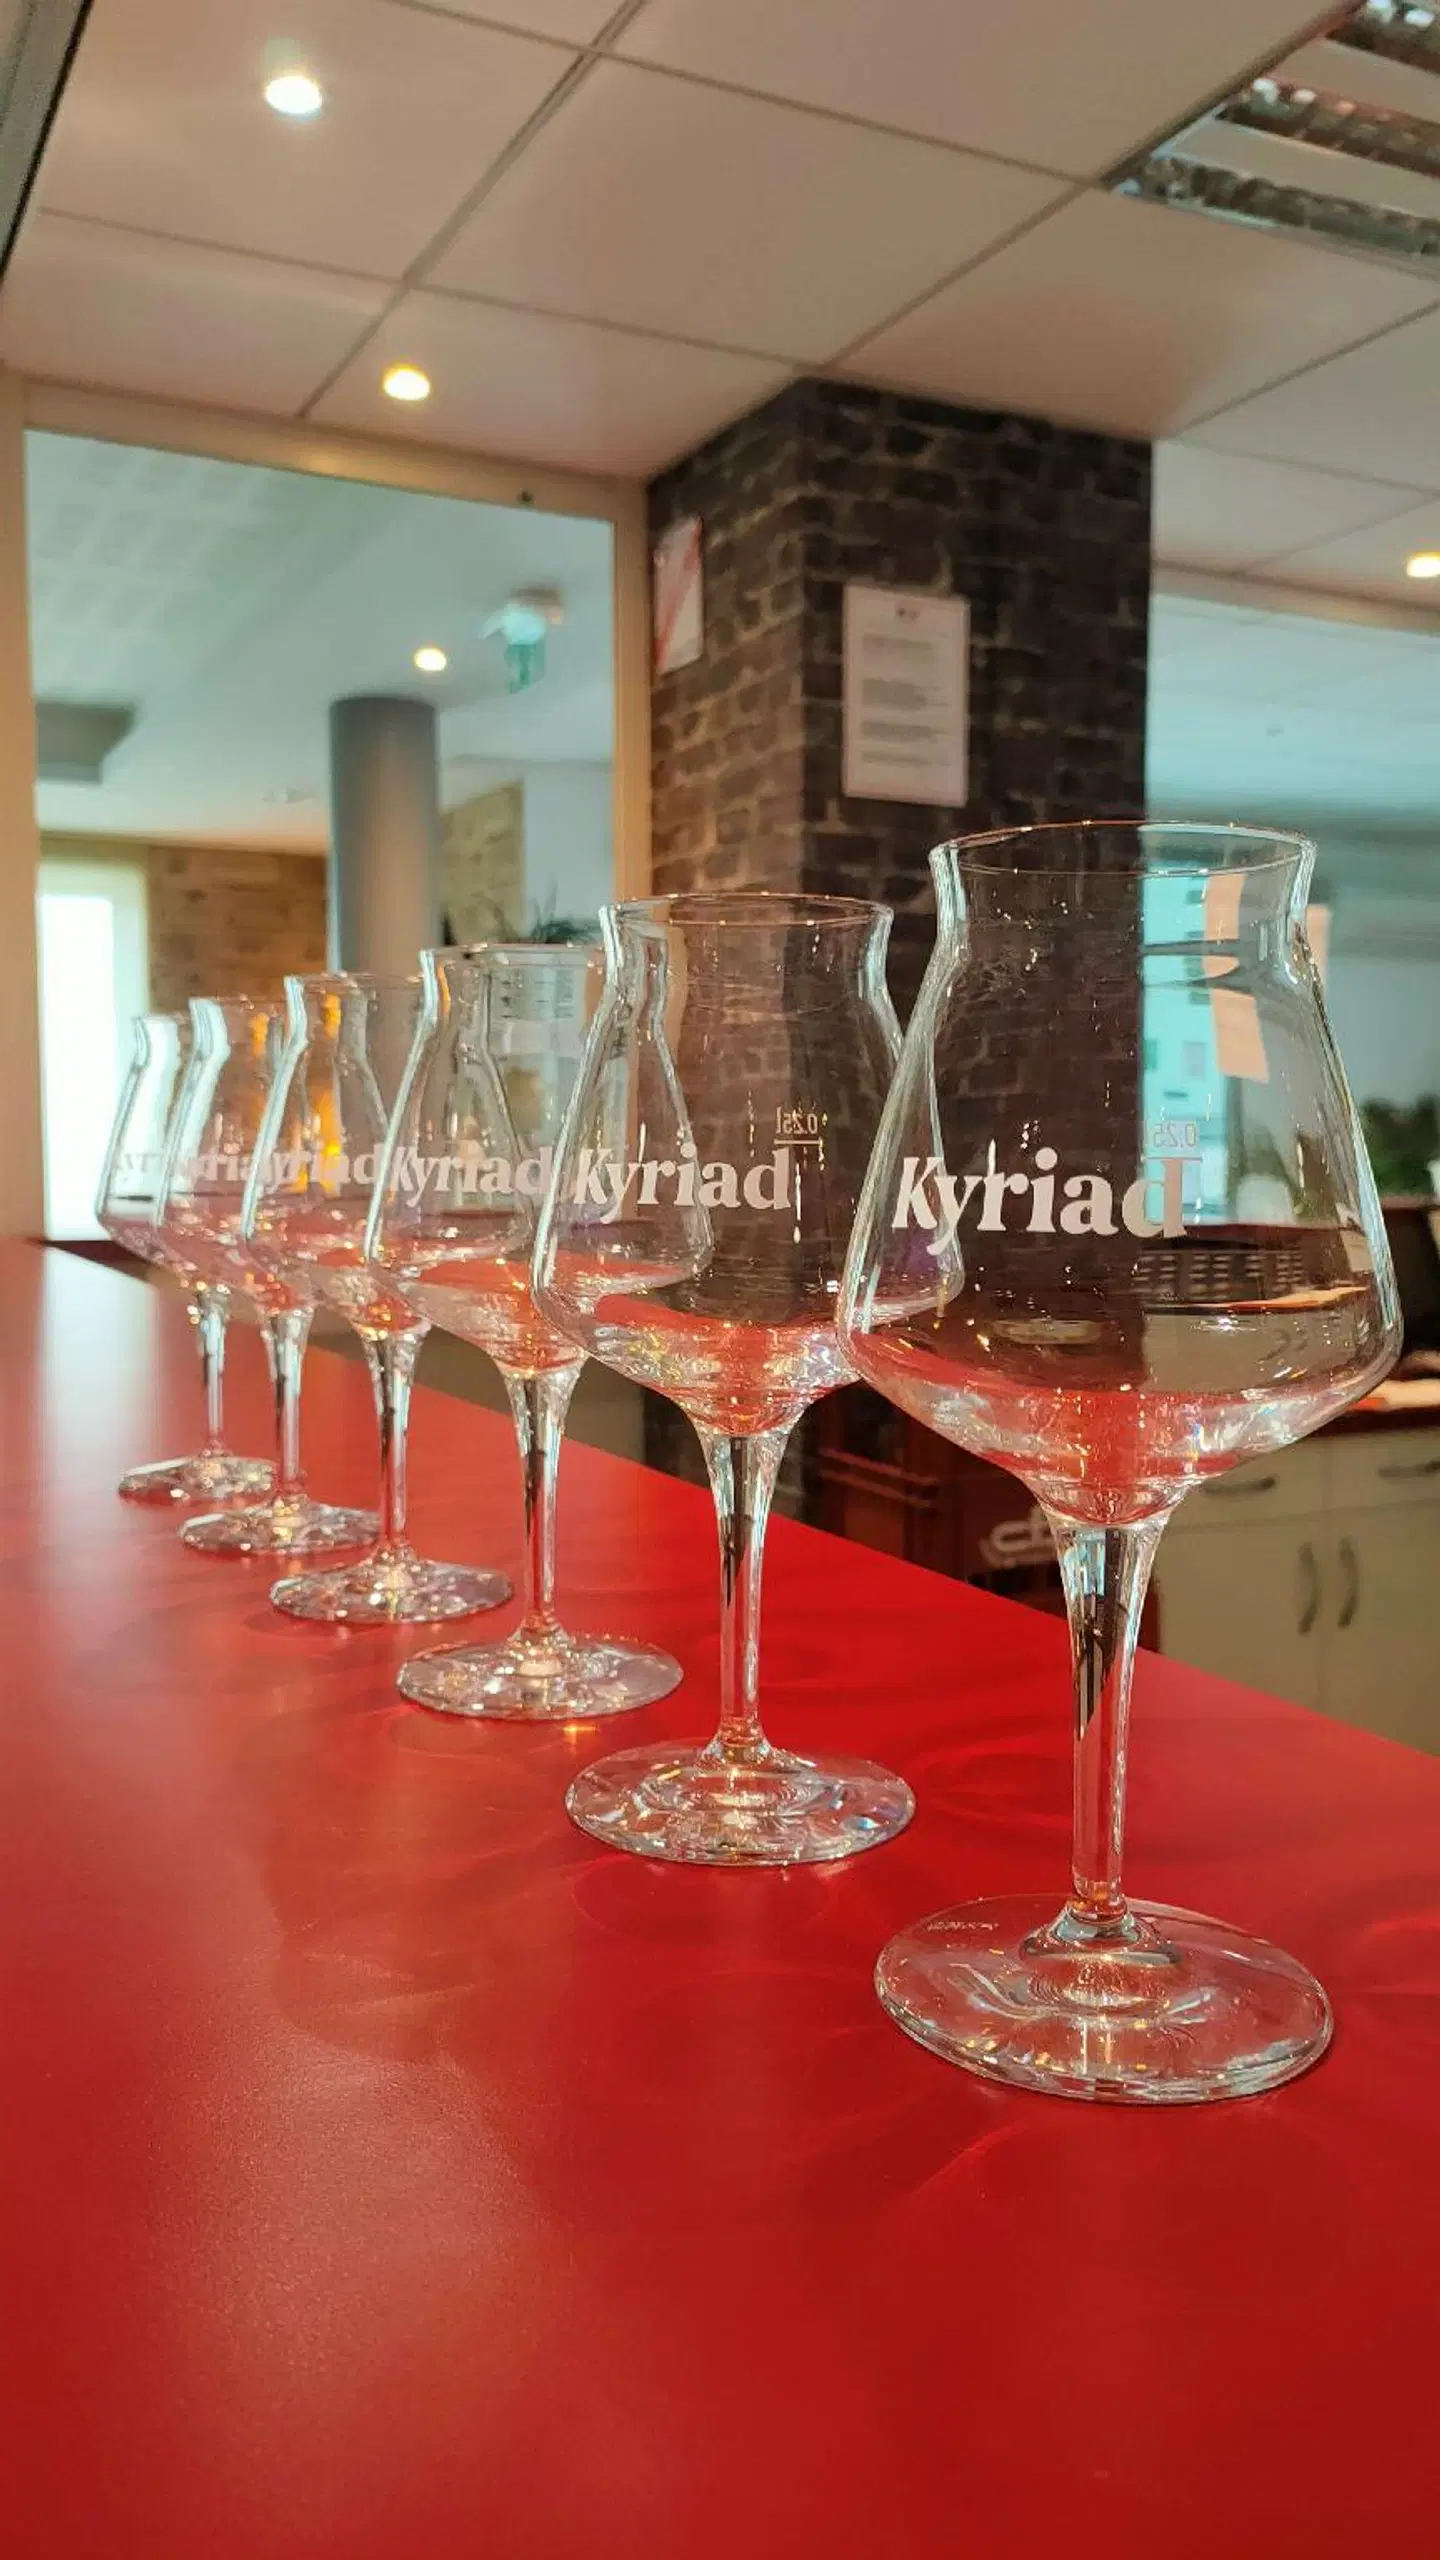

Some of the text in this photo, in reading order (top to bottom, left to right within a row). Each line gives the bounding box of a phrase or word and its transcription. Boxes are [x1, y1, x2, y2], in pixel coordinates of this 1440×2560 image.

[390, 1145, 554, 1208] Kyriad
[573, 1147, 791, 1224] Kyriad
[891, 1147, 1188, 1255] Kyriad
